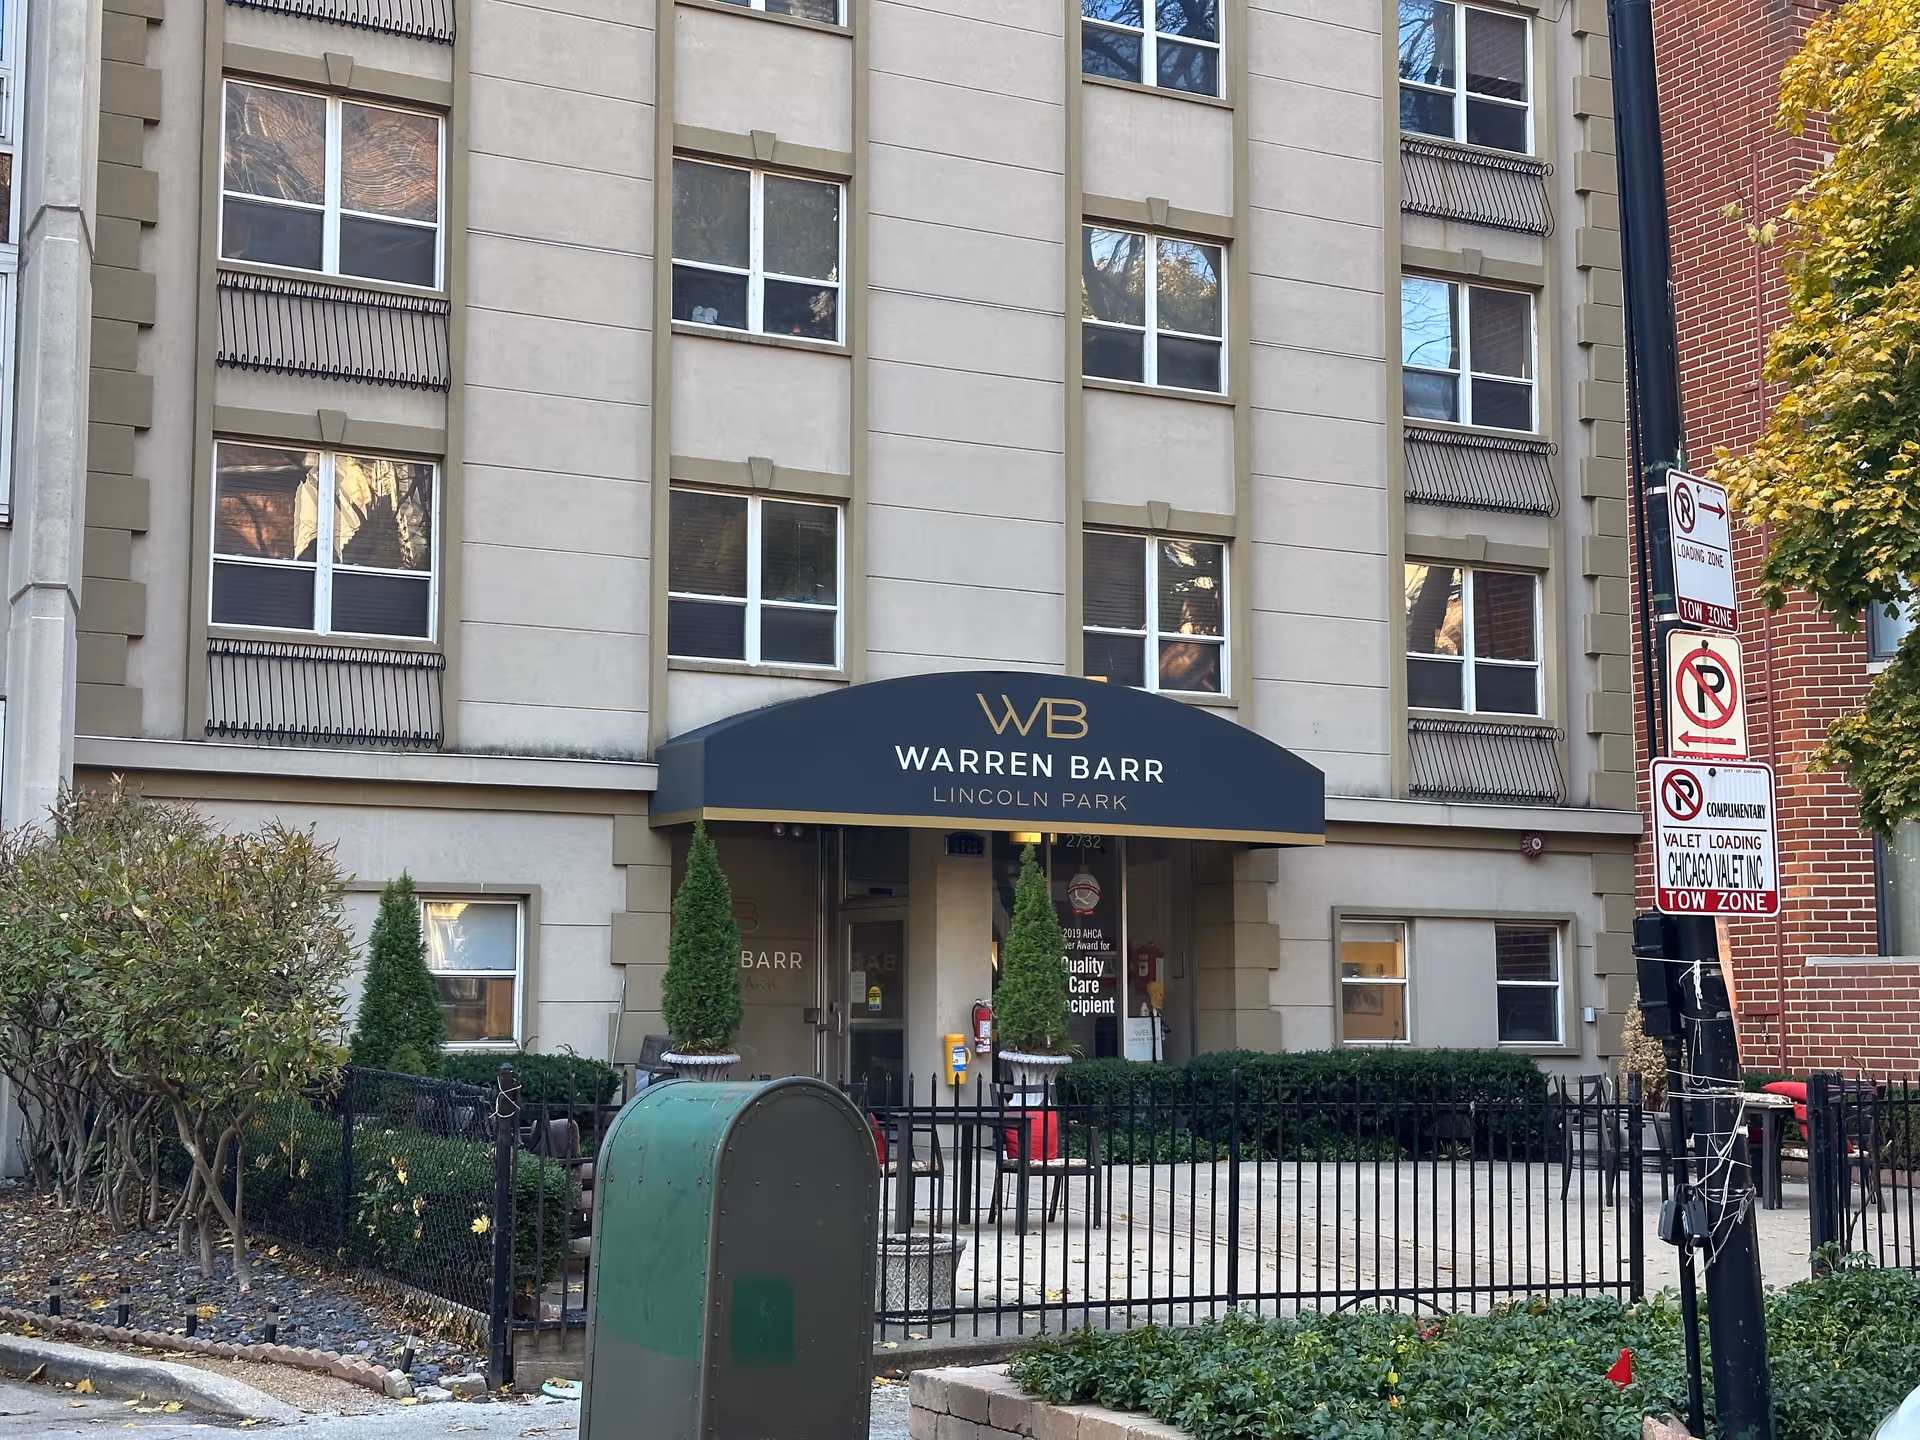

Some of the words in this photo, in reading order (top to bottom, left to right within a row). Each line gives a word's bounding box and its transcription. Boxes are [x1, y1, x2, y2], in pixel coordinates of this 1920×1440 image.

[1677, 543, 1704, 564] LOADING
[1707, 551, 1724, 568] ZONE
[1682, 599, 1703, 621] TOW
[1707, 606, 1733, 628] ZONE
[976, 693, 1088, 739] WB
[895, 745, 1053, 778] WARREN
[1070, 755, 1164, 783] BARR
[933, 786, 1048, 807] LINCOLN
[1062, 792, 1127, 811] PARK
[1706, 801, 1766, 819] COMPLIMENTARY
[1066, 834, 1101, 849] 2732
[1663, 832, 1701, 848] VALET
[1709, 834, 1762, 850] LOADING
[1668, 851, 1713, 888] CHICAGO
[1714, 854, 1744, 889] VALET
[1746, 854, 1763, 889] INC
[1665, 890, 1706, 910] TOW
[1717, 891, 1768, 911] ZONE
[1063, 928, 1081, 939] 2019
[1083, 929, 1103, 939] AHCA
[1064, 941, 1075, 950] ver
[1077, 940, 1098, 951] Award
[1100, 940, 1110, 951] for
[741, 950, 802, 969] BARR
[744, 976, 777, 991] ARK
[1069, 976, 1100, 994] Care
[1063, 996, 1115, 1017] ecipient
